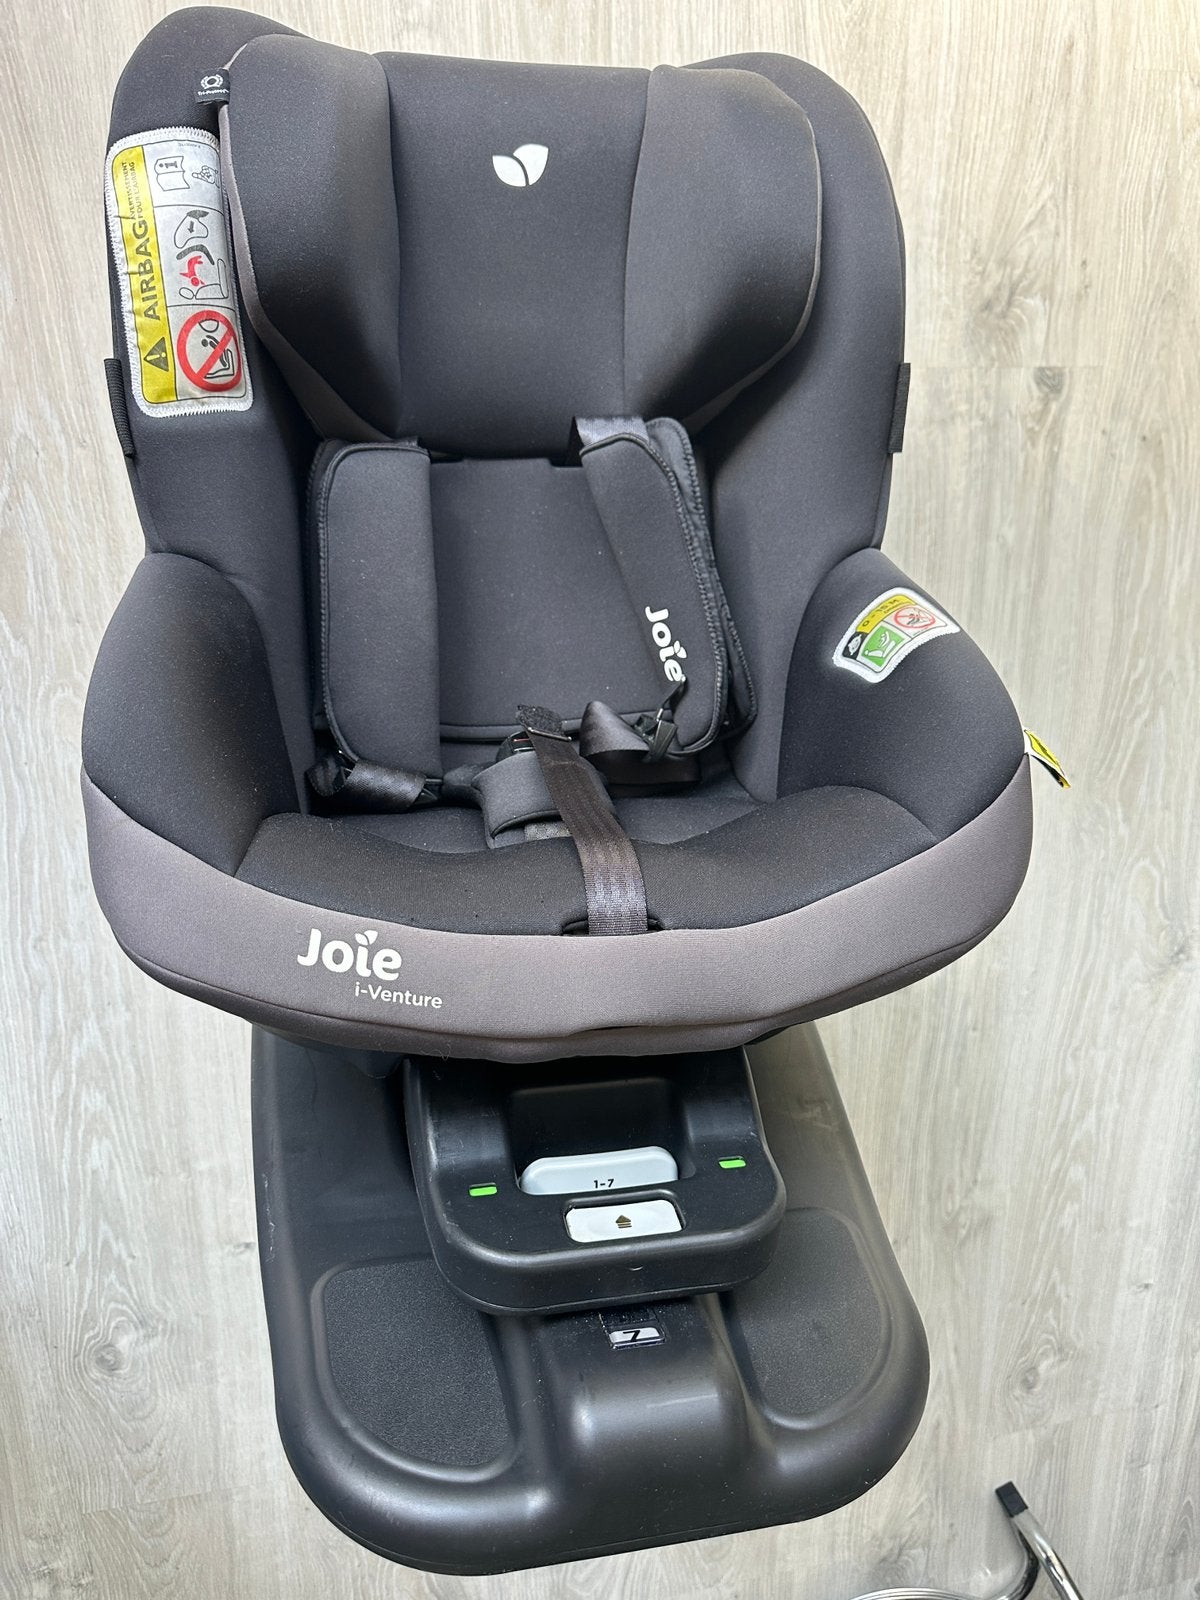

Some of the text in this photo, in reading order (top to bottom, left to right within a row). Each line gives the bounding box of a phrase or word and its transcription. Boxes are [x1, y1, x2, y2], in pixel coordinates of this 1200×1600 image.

[132, 219, 160, 321] AIRBAG
[644, 606, 687, 682] Joie
[297, 928, 402, 981] Joie
[354, 981, 443, 1009] i-Venture
[593, 1178, 615, 1189] 1-7
[622, 1329, 641, 1342] 7
